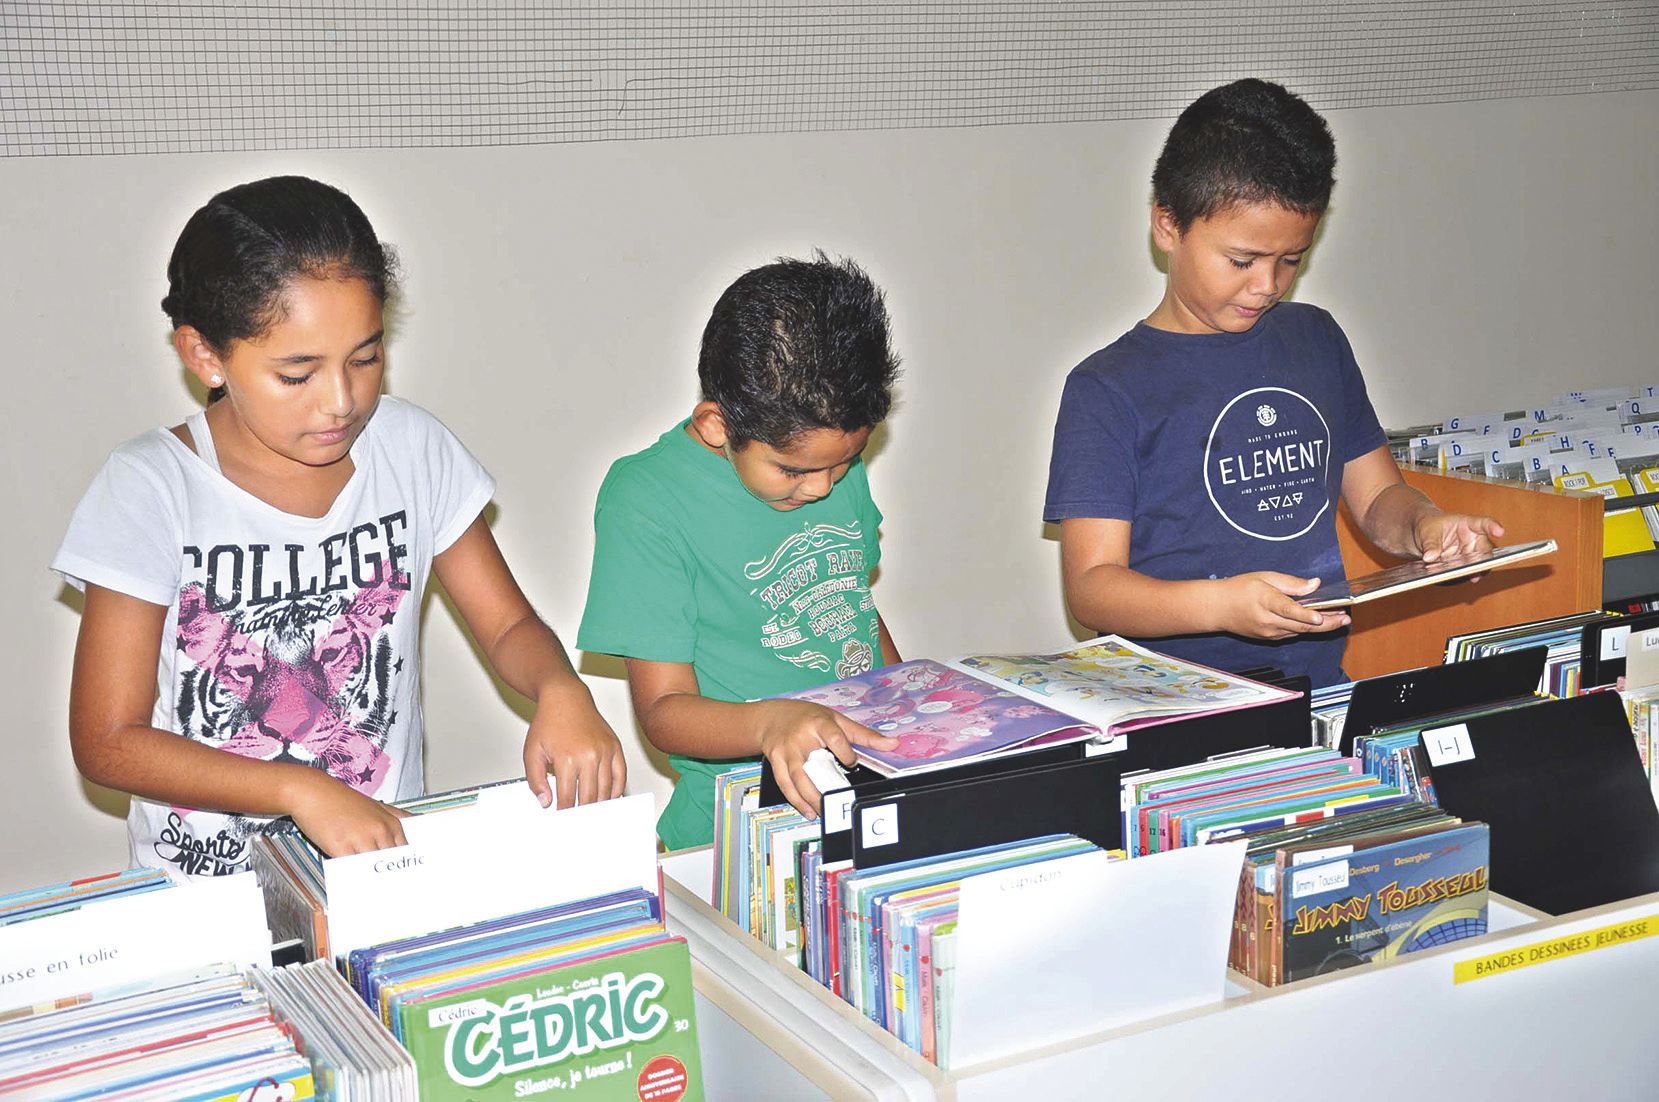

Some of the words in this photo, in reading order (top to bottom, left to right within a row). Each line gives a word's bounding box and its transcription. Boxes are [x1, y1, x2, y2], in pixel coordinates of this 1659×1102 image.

[1534, 409, 1546, 421] M
[1631, 402, 1641, 415] Q
[1450, 418, 1460, 430] G
[1483, 425, 1491, 436] F
[1512, 427, 1522, 439] D
[1560, 435, 1570, 449] H
[1452, 444, 1462, 457] D
[1491, 450, 1501, 464] C
[1218, 439, 1325, 486] ELEMENT
[1532, 457, 1542, 471] B
[1561, 464, 1570, 476] A
[182, 509, 412, 614] COLLEGE
[759, 557, 818, 610] TRICOT
[1611, 636, 1620, 652] L
[871, 817, 886, 837] C
[158, 811, 247, 861] Sports
[1292, 892, 1372, 936] JIMMY
[1376, 865, 1488, 916] TOUSSEUL
[1344, 933, 1355, 943] Le
[1475, 952, 1525, 976] BANDES
[1529, 935, 1591, 962] DESSINEES
[1595, 921, 1649, 948] JEUNESSE
[47, 960, 69, 974] en
[513, 1076, 567, 1097] Silence,
[569, 1068, 582, 1088] je
